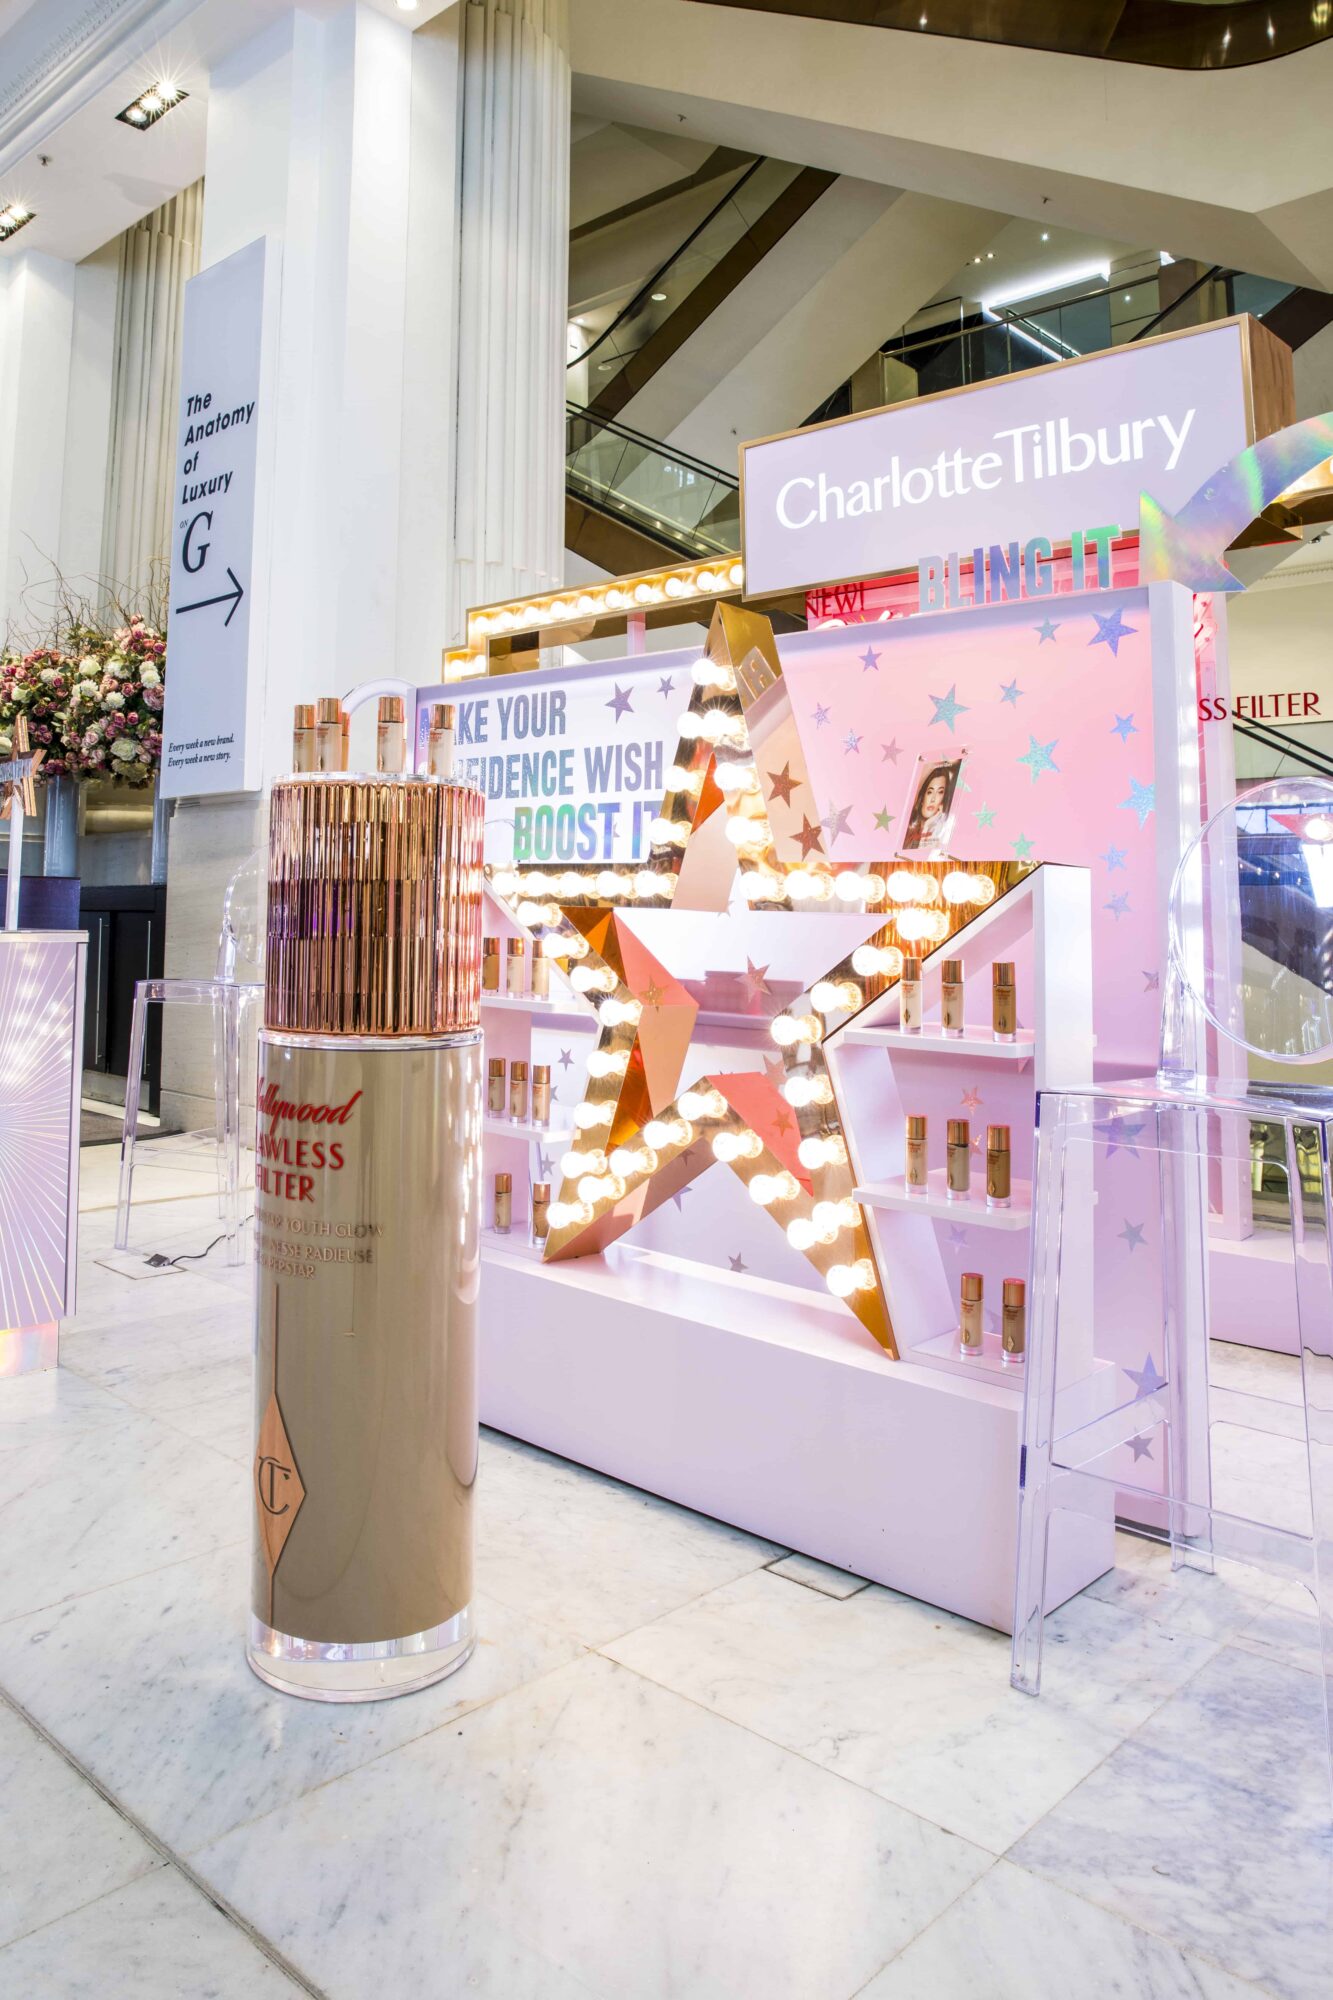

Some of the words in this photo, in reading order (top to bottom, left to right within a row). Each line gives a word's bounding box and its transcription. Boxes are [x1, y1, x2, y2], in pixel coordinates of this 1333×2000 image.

[187, 393, 212, 417] The
[184, 401, 255, 447] Anatomy
[183, 450, 199, 475] of
[182, 470, 233, 505] Luxury
[182, 510, 214, 573] G
[918, 536, 1053, 613] BLING
[1071, 524, 1122, 593] IT
[805, 582, 865, 619] NEW!
[497, 690, 566, 741] YOUR
[1235, 692, 1322, 720] FILTER
[168, 742, 184, 754] Every
[185, 738, 199, 750] week
[204, 738, 216, 747] new
[168, 757, 184, 769] Every
[185, 753, 198, 765] week
[203, 754, 215, 762] new
[583, 740, 663, 794] WISH
[513, 802, 621, 861] BOOST
[257, 1132, 345, 1171] AWLESS
[286, 1217, 331, 1236] YOUTH
[335, 1223, 385, 1239] GLOW
[305, 1245, 374, 1264] RADIEUSE
